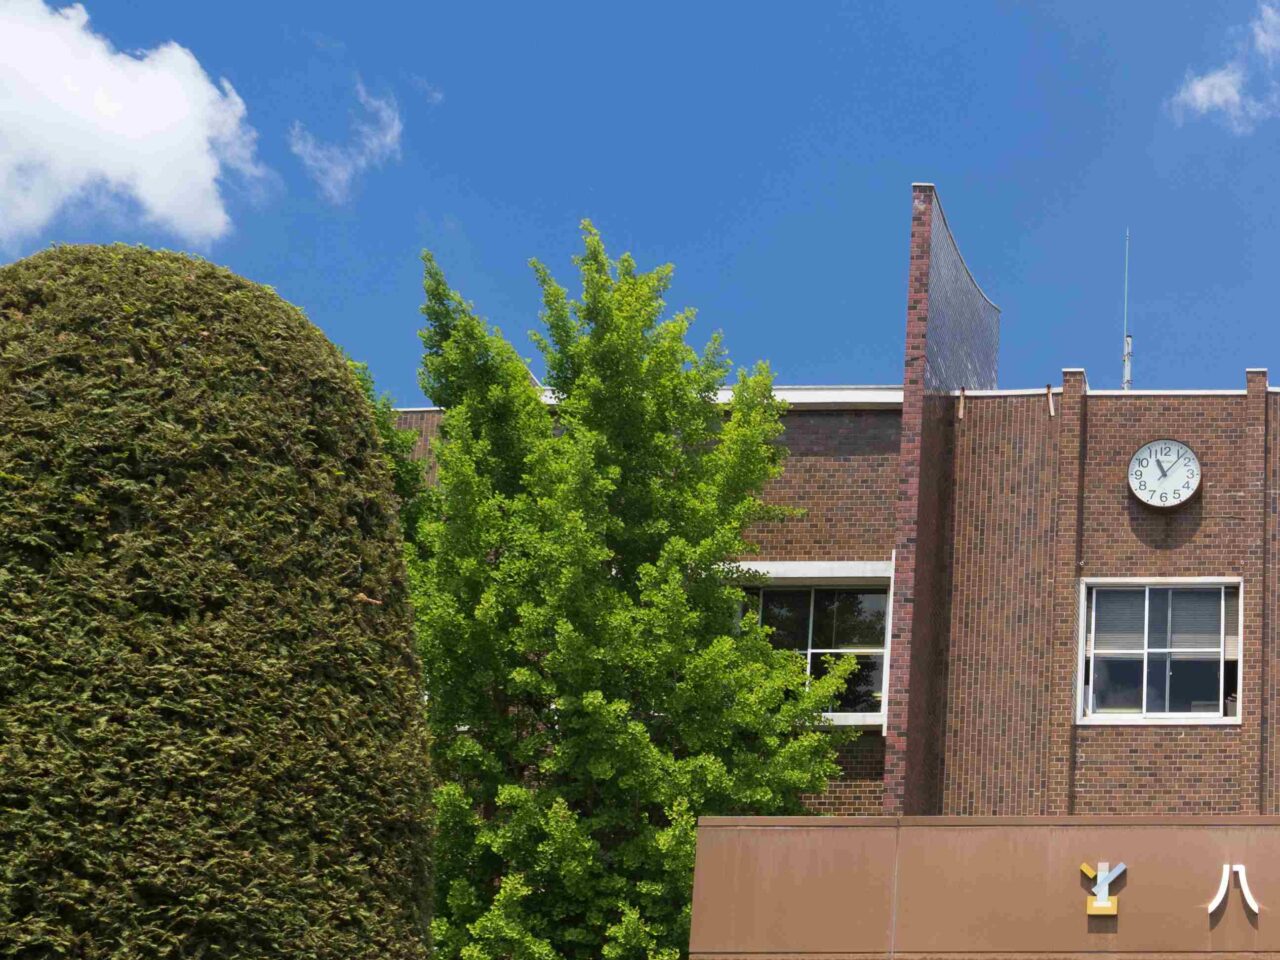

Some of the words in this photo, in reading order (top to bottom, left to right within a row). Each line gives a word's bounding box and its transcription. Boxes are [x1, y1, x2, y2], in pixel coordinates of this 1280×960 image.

[1161, 446, 1171, 457] 12
[1138, 457, 1149, 468] 10
[1183, 456, 1191, 467] 2
[1134, 469, 1143, 480] 9
[1186, 469, 1195, 480] 3
[1138, 480, 1147, 491] 8
[1182, 481, 1190, 490] 4
[1148, 489, 1156, 500] 7
[1159, 492, 1168, 503] 6
[1172, 489, 1181, 500] 5
